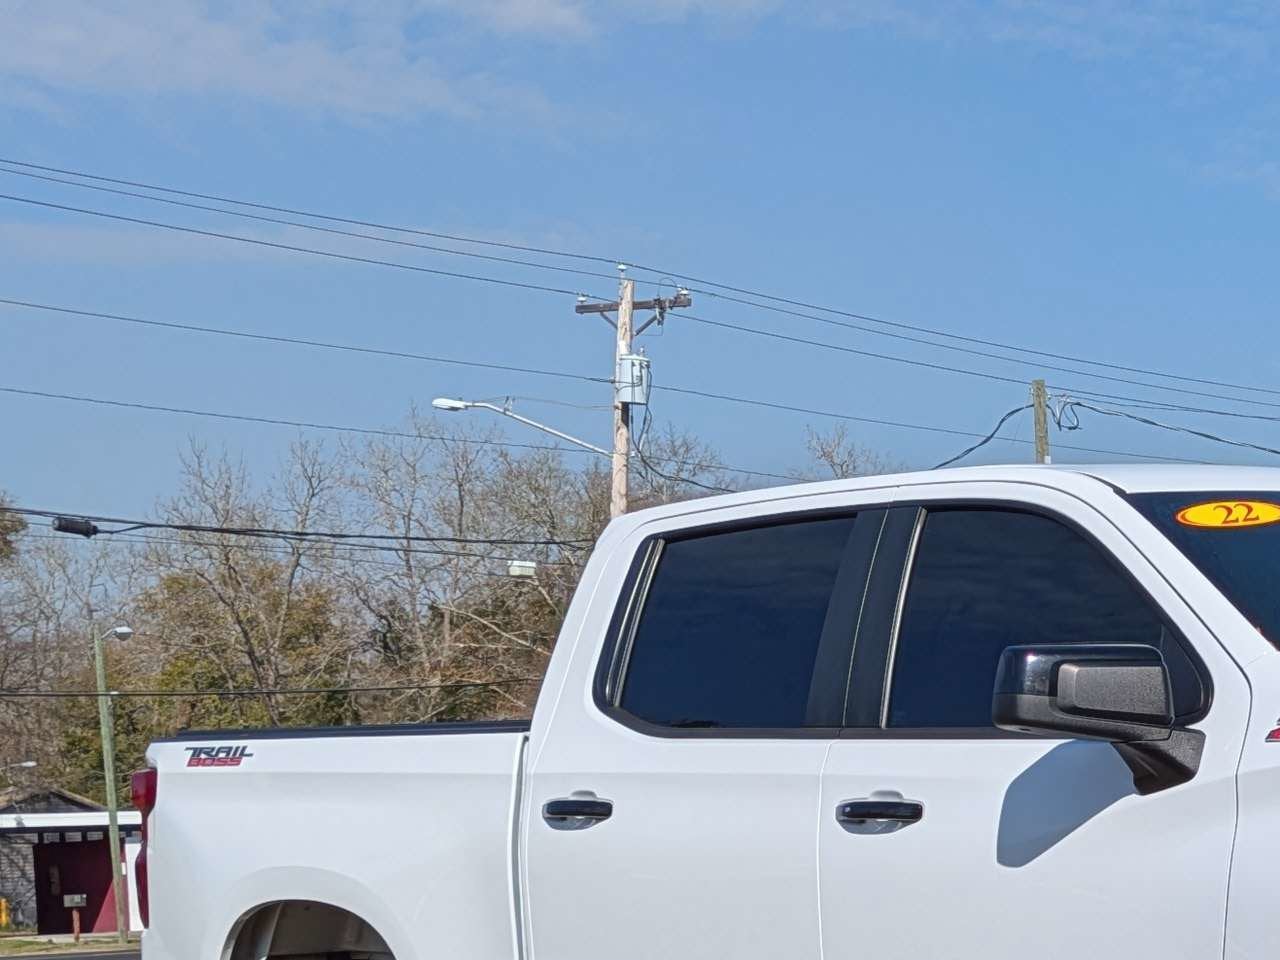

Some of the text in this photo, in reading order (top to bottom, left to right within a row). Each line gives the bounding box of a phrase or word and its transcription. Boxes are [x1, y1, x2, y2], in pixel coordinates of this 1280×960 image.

[1213, 503, 1260, 525] 22
[184, 745, 254, 758] TRAIL
[187, 757, 243, 767] BOSS
